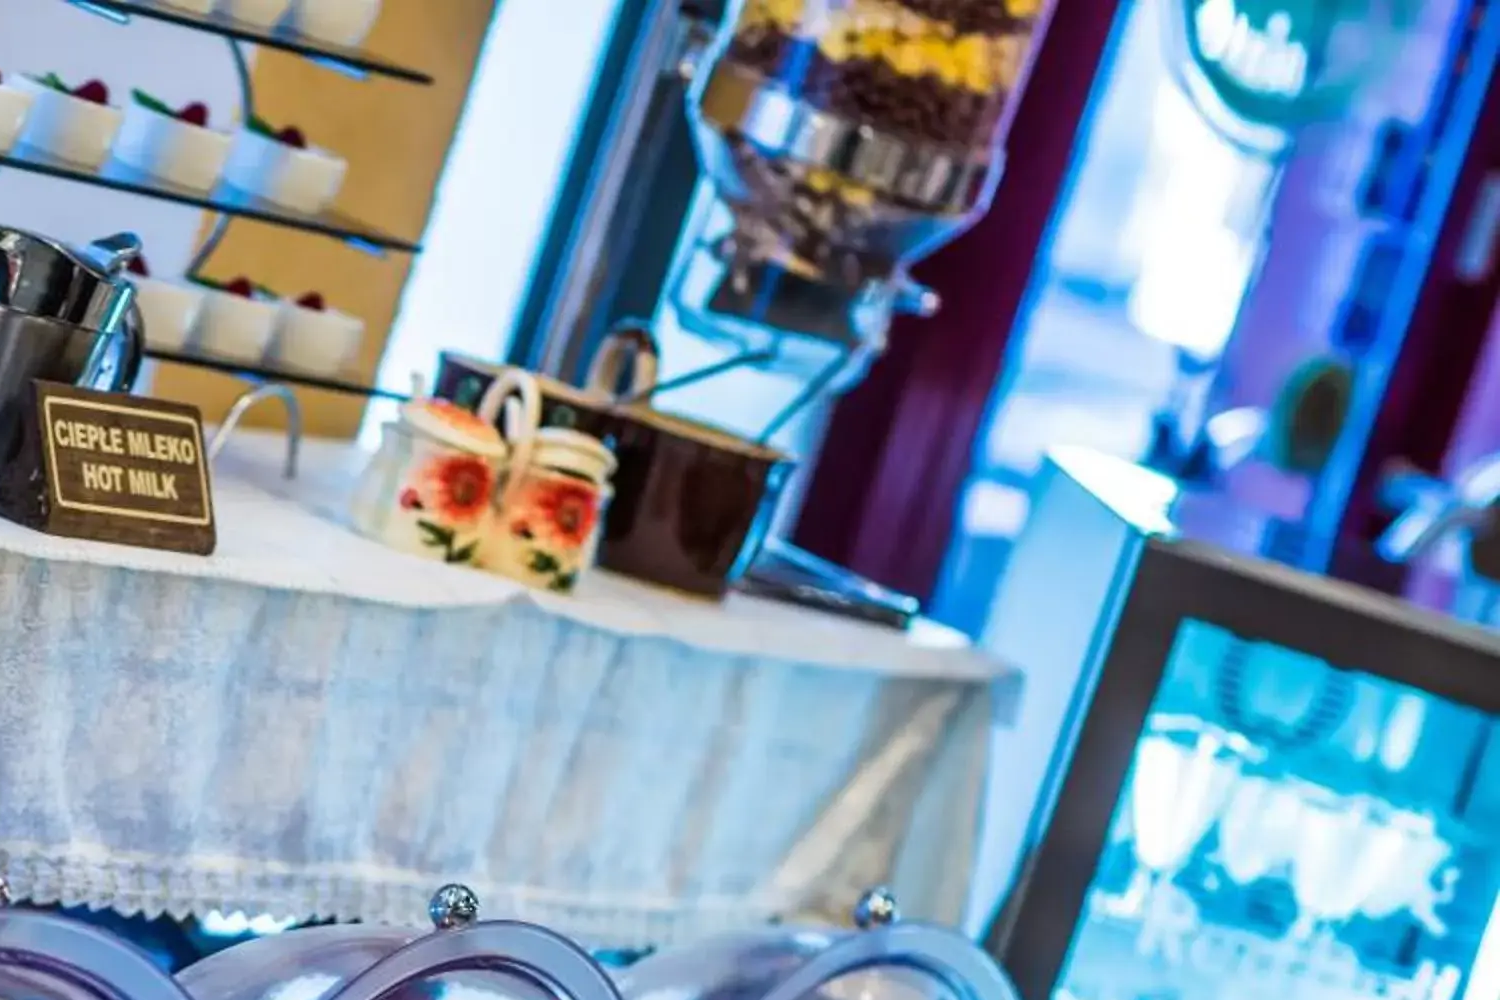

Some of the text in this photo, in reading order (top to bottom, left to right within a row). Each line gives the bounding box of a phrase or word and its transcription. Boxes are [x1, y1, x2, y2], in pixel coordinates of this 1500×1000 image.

[54, 418, 196, 465] CIEPŁE MLEKO
[82, 461, 179, 500] HOT MILK
